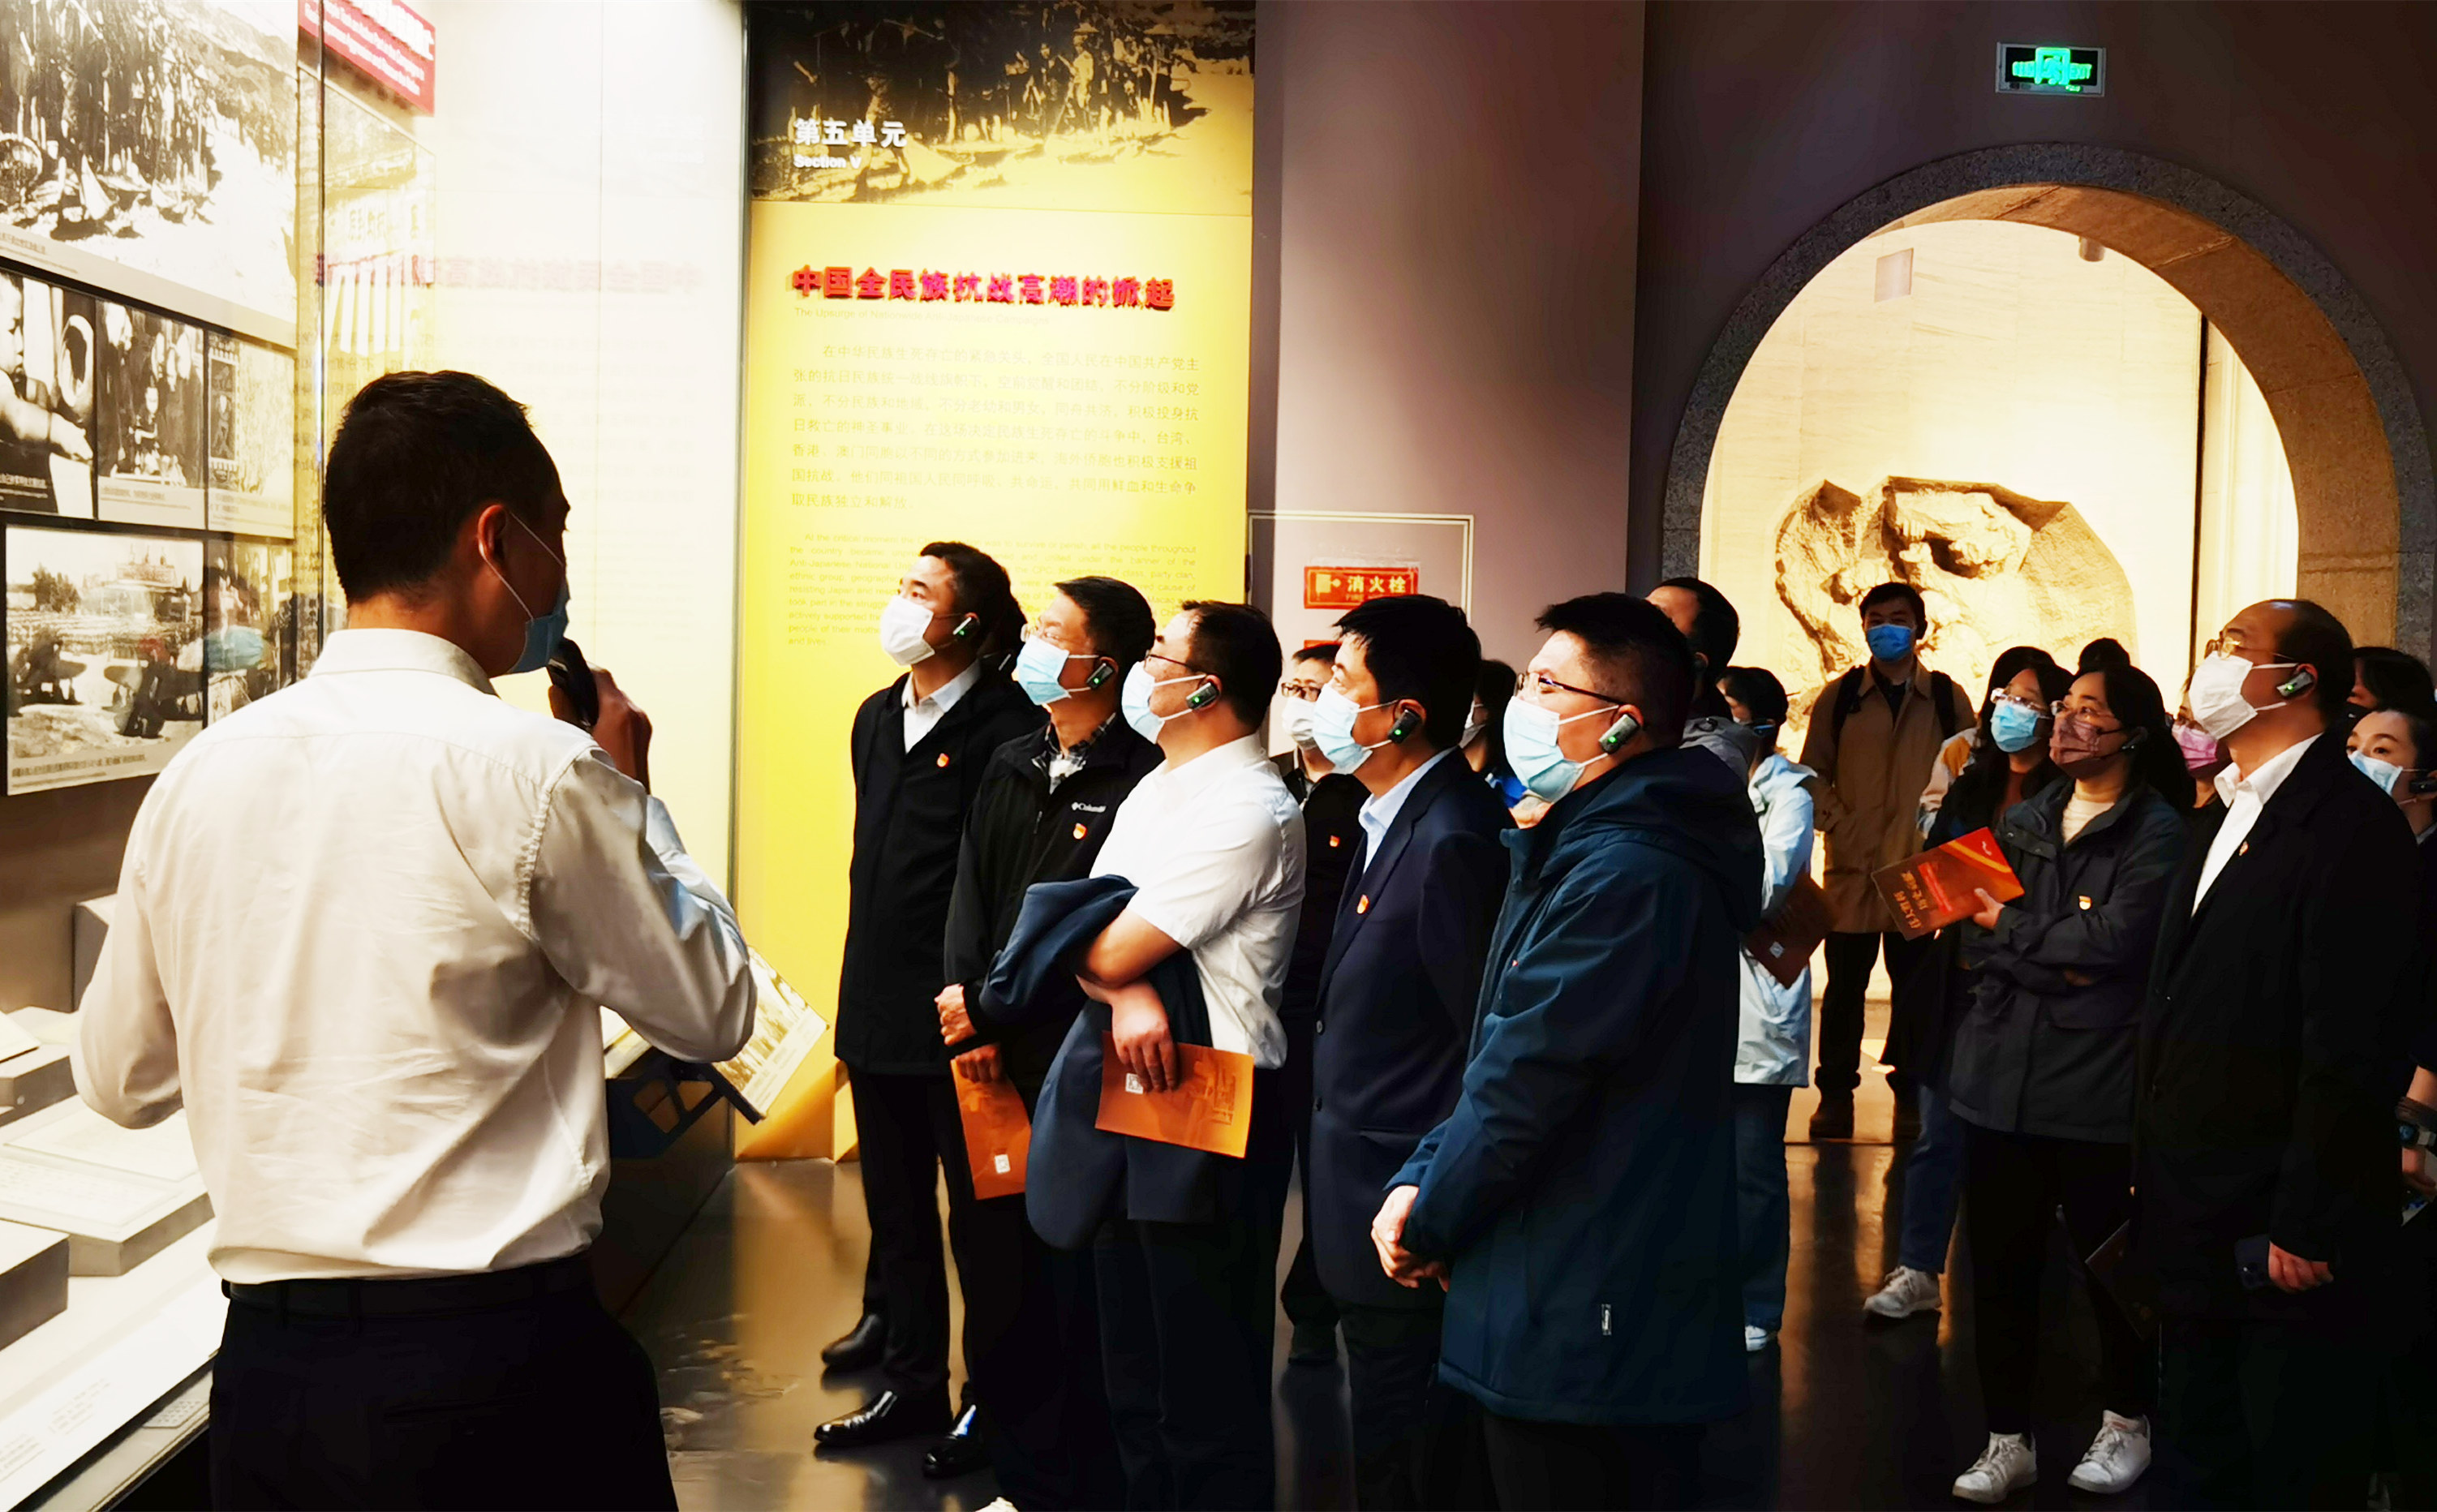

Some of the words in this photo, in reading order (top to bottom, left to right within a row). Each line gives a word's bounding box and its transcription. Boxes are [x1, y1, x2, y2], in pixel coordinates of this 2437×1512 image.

[794, 118, 907, 148] 第五单元
[793, 154, 846, 168] Section
[849, 154, 862, 169] V
[793, 264, 1175, 311] 中国全民族抗战高潮的掀起
[795, 307, 812, 318] The
[815, 308, 856, 320] Upsurge
[859, 309, 868, 319] of
[1347, 575, 1406, 593] 消火栓
